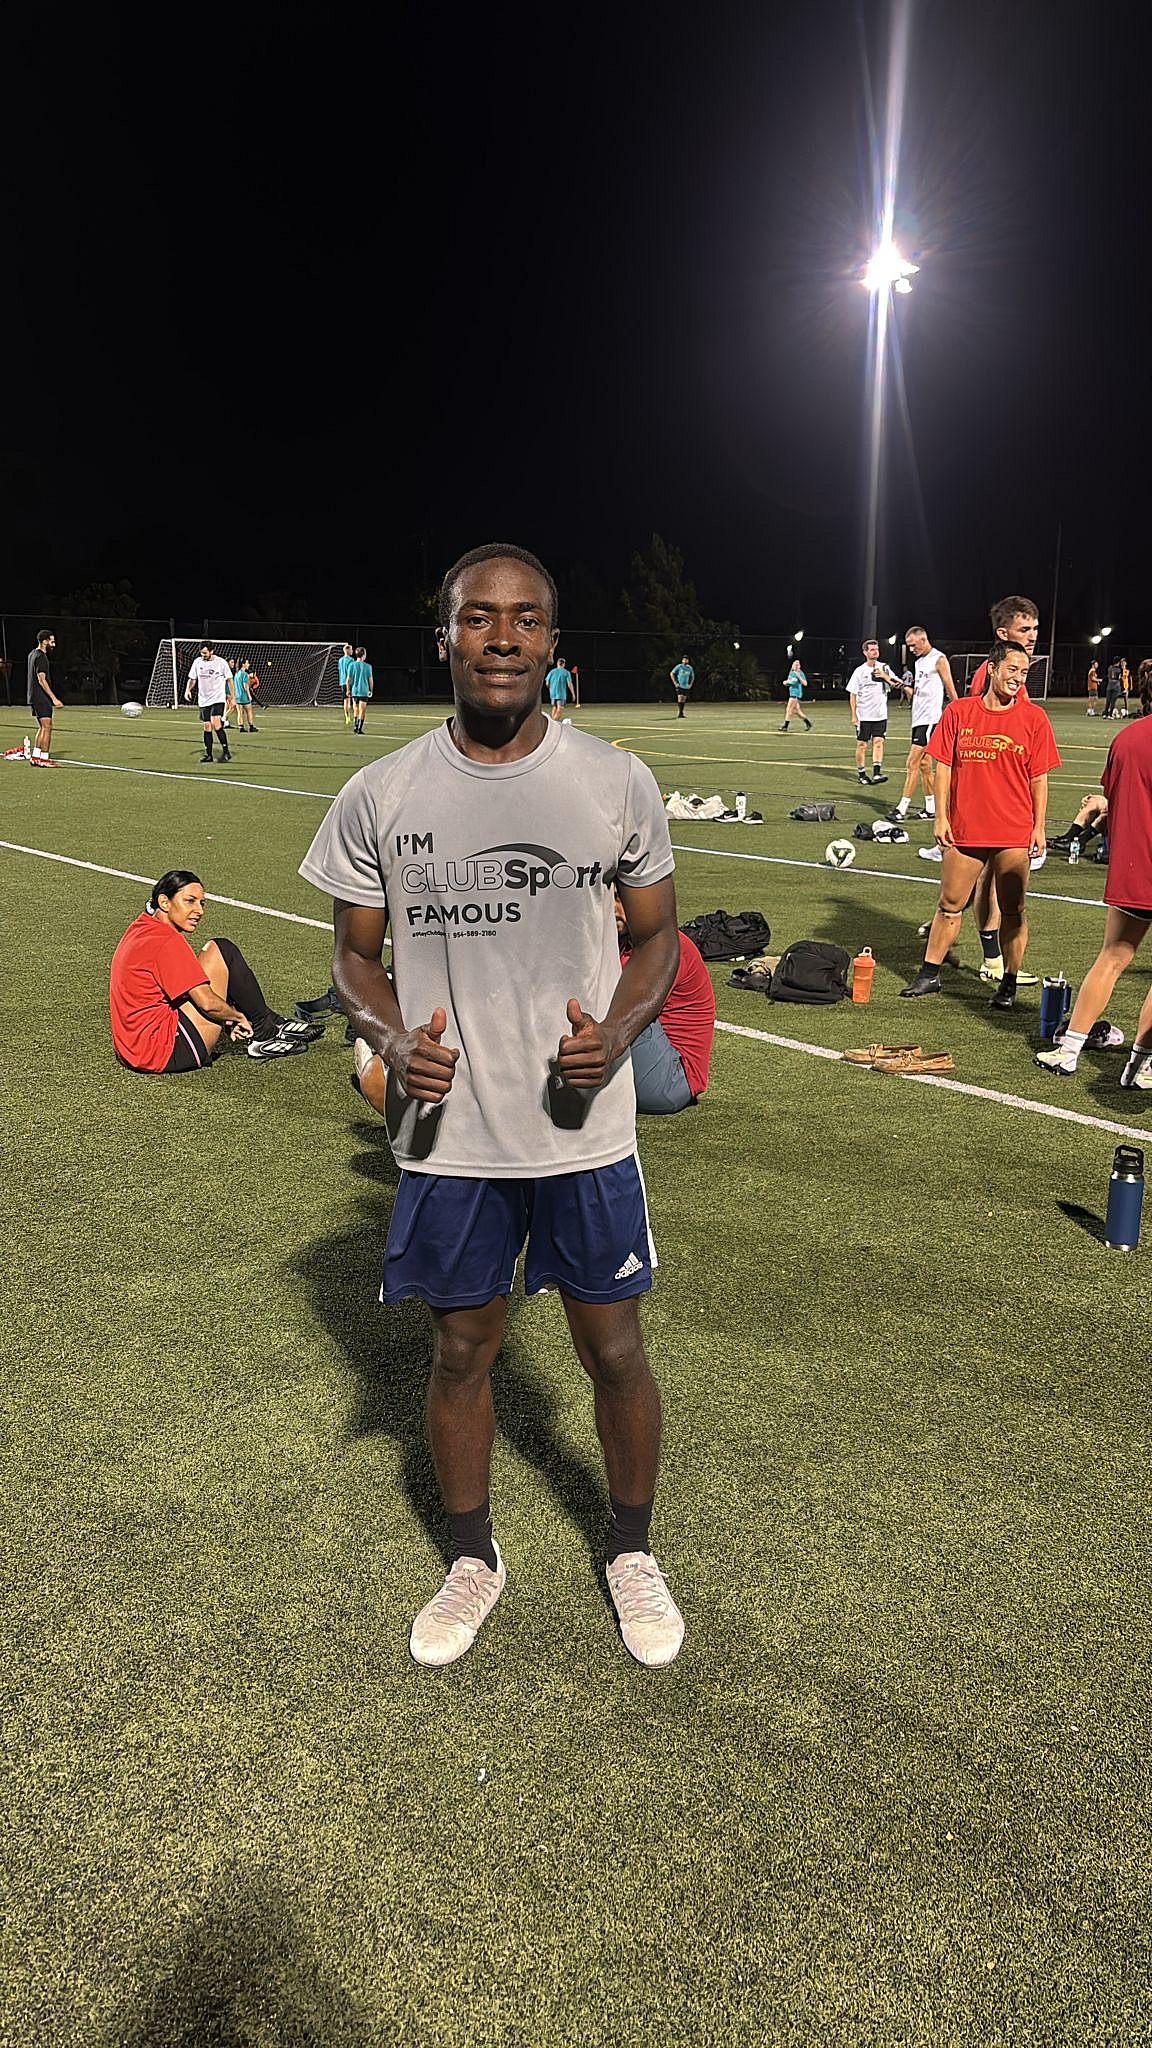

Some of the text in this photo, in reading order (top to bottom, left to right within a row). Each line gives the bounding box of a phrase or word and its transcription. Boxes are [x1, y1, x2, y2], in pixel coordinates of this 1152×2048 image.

[960, 736, 1024, 755] CLUBSport
[960, 750, 997, 760] FAMOUS
[396, 832, 434, 857] I'M
[401, 859, 602, 896] CLUBSport
[406, 902, 521, 926] FAMOUS
[614, 1261, 644, 1280] adidas
